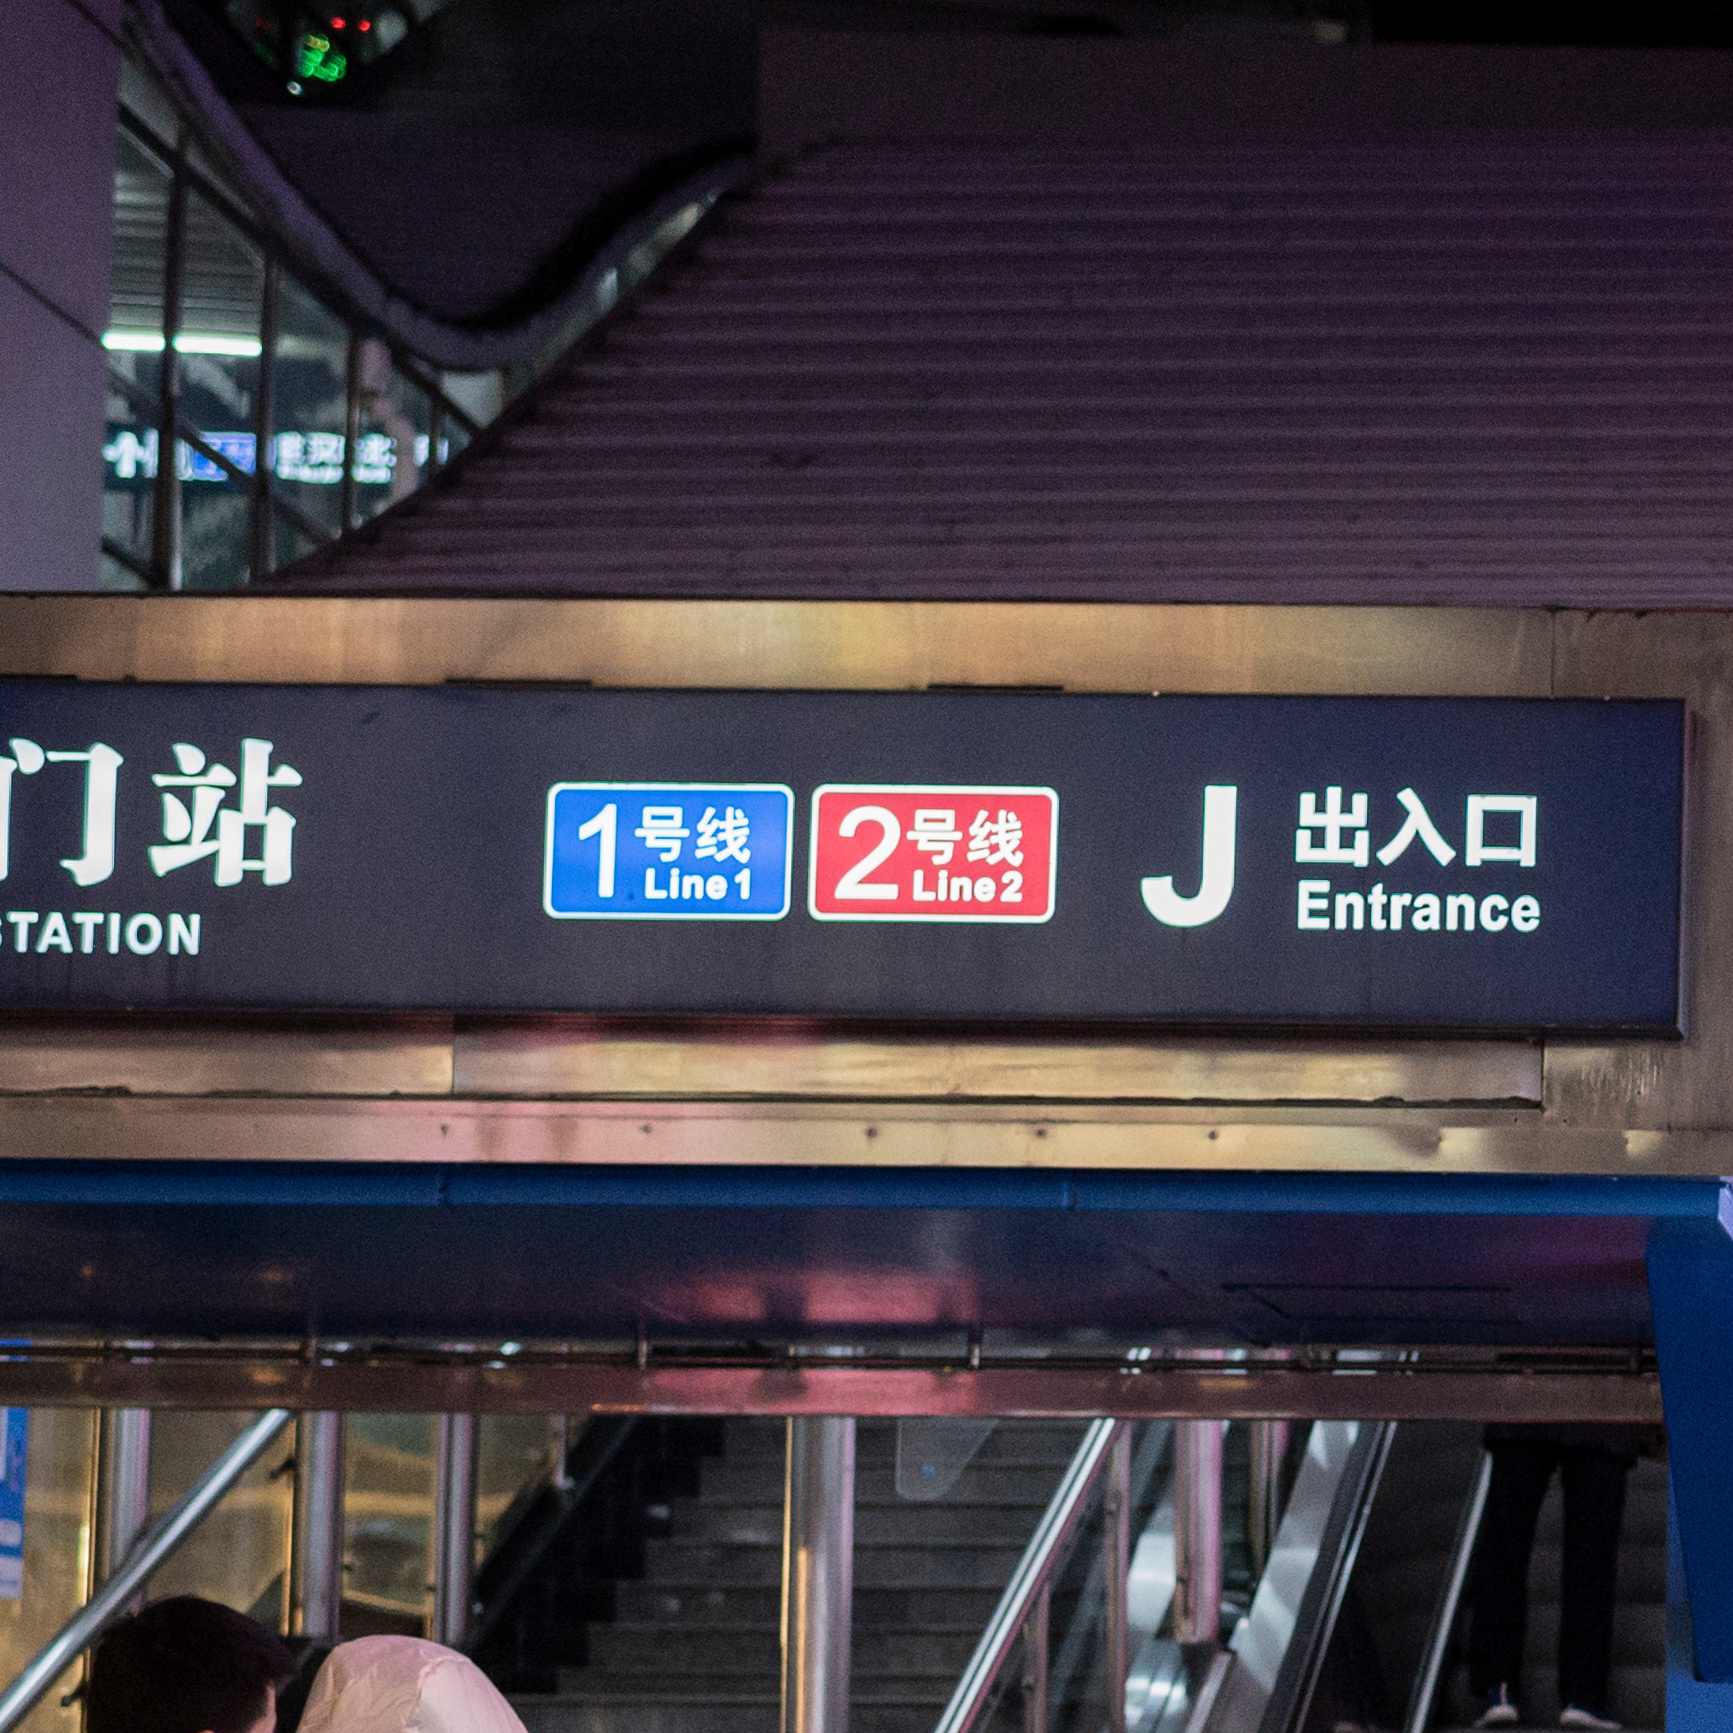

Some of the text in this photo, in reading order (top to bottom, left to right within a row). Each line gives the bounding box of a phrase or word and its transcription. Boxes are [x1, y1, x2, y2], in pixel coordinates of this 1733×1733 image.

[1140, 785, 1239, 928] J
[1294, 786, 1539, 868] 出入口
[0, 910, 201, 956] TATION
[1296, 877, 1542, 934] Entrance
